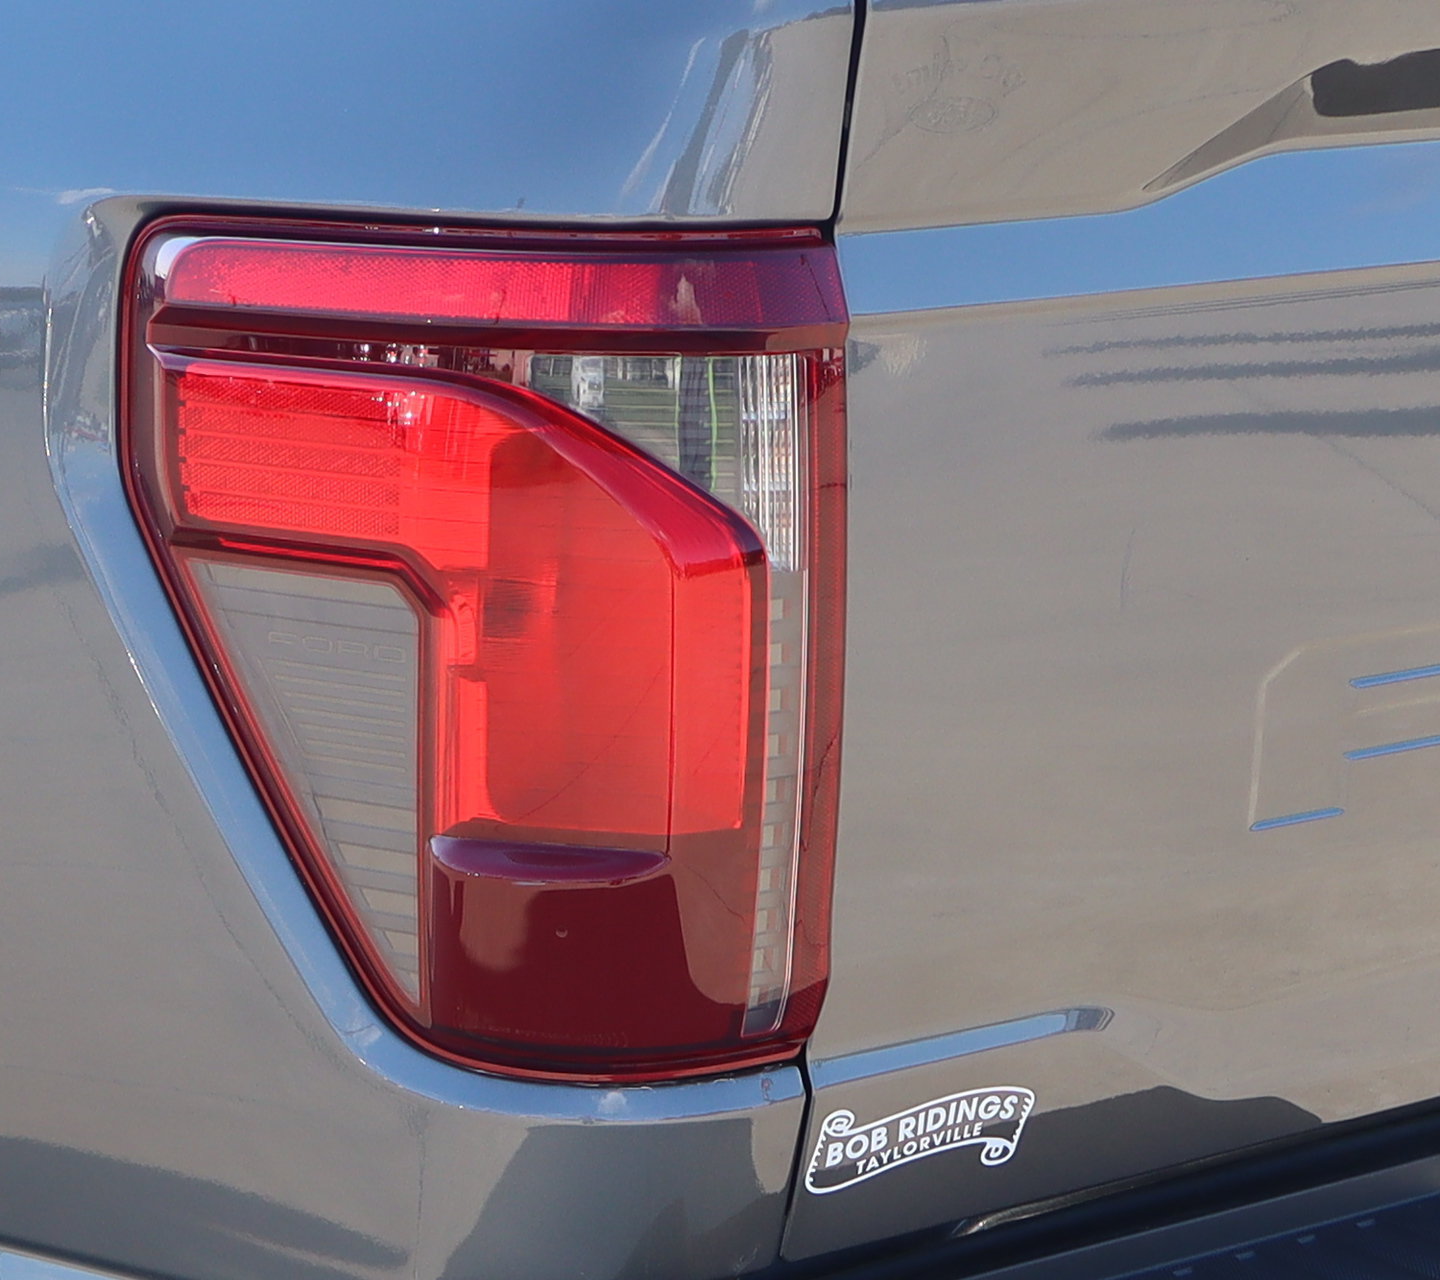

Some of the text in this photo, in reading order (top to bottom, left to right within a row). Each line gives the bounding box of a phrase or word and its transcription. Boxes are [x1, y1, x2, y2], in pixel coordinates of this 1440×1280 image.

[268, 631, 406, 664] FORD
[825, 1095, 1019, 1168] BOB RIDINGS
[856, 1122, 983, 1175] TAYLORVILLE
